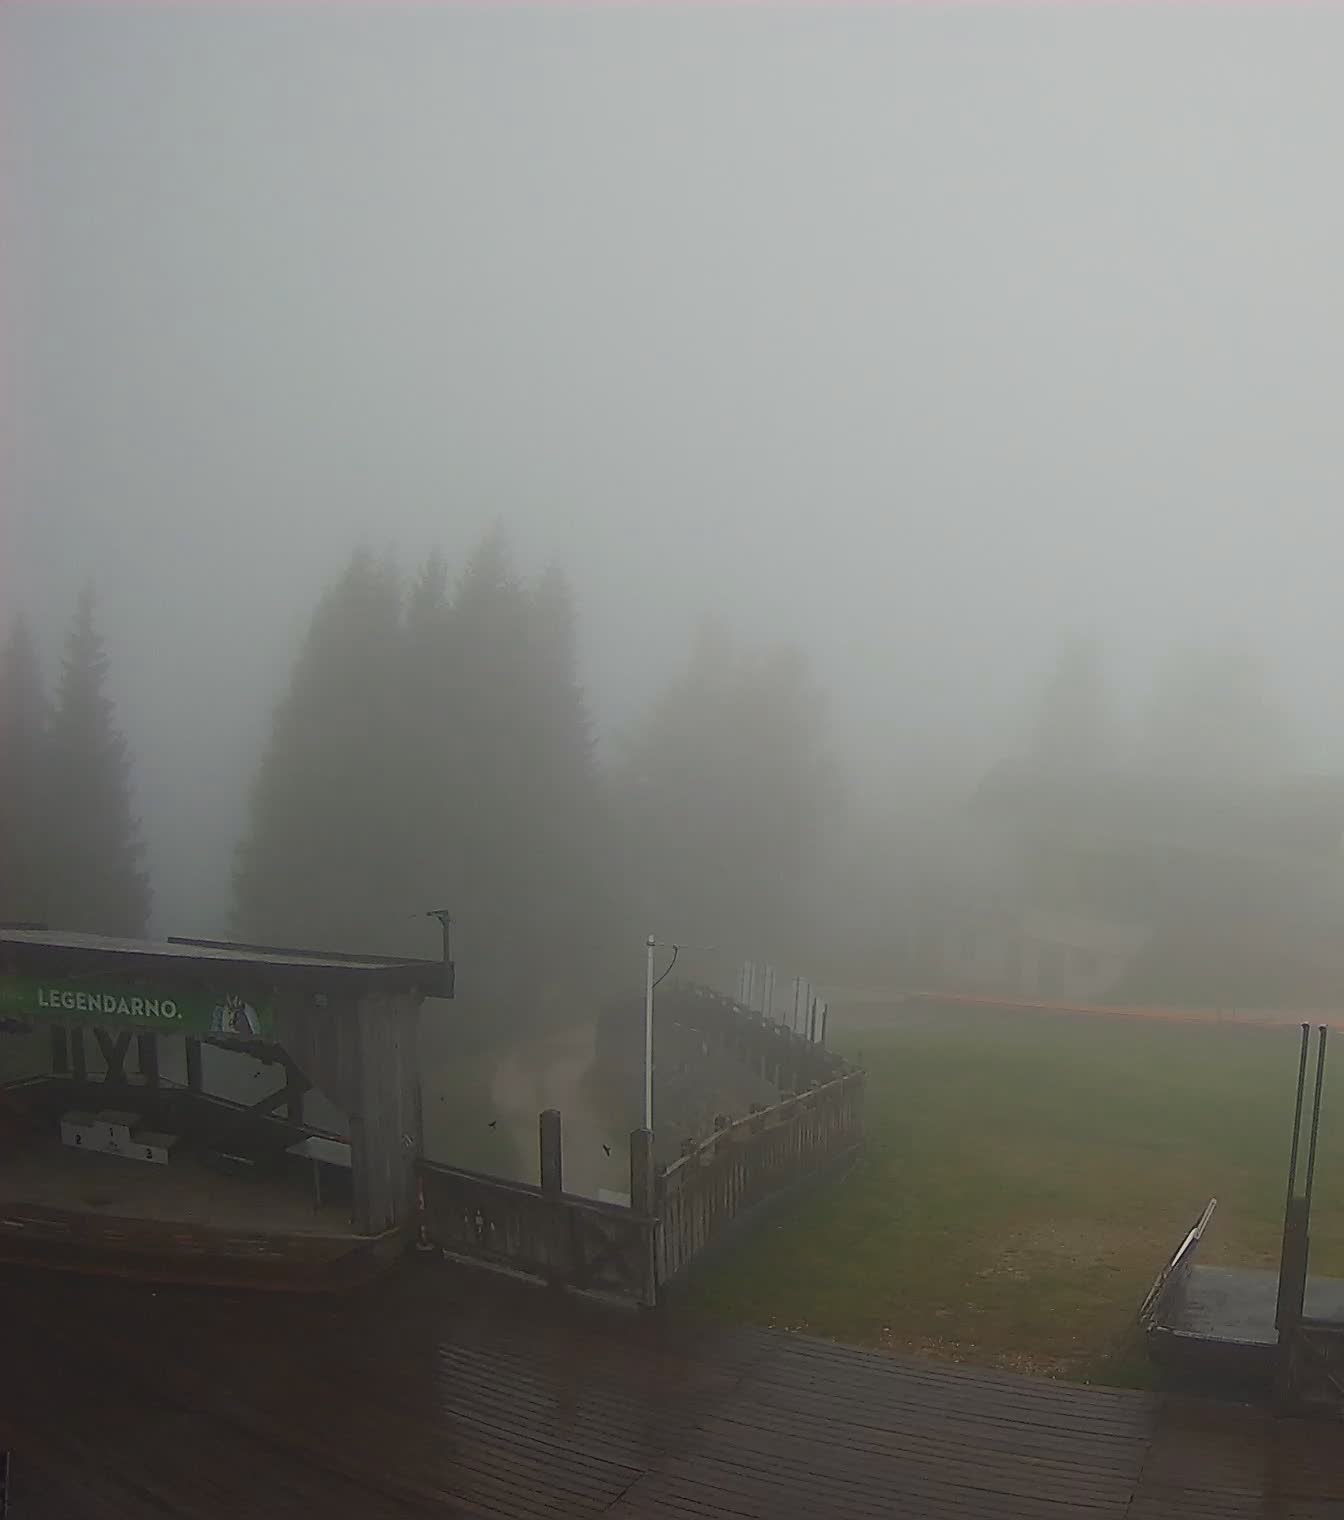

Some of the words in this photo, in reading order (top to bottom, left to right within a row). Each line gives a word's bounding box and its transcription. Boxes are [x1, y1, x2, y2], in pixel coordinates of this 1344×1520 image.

[37, 987, 183, 1019] LEGENDARNO.
[75, 1134, 82, 1145] 2
[145, 1147, 153, 1159] 3
